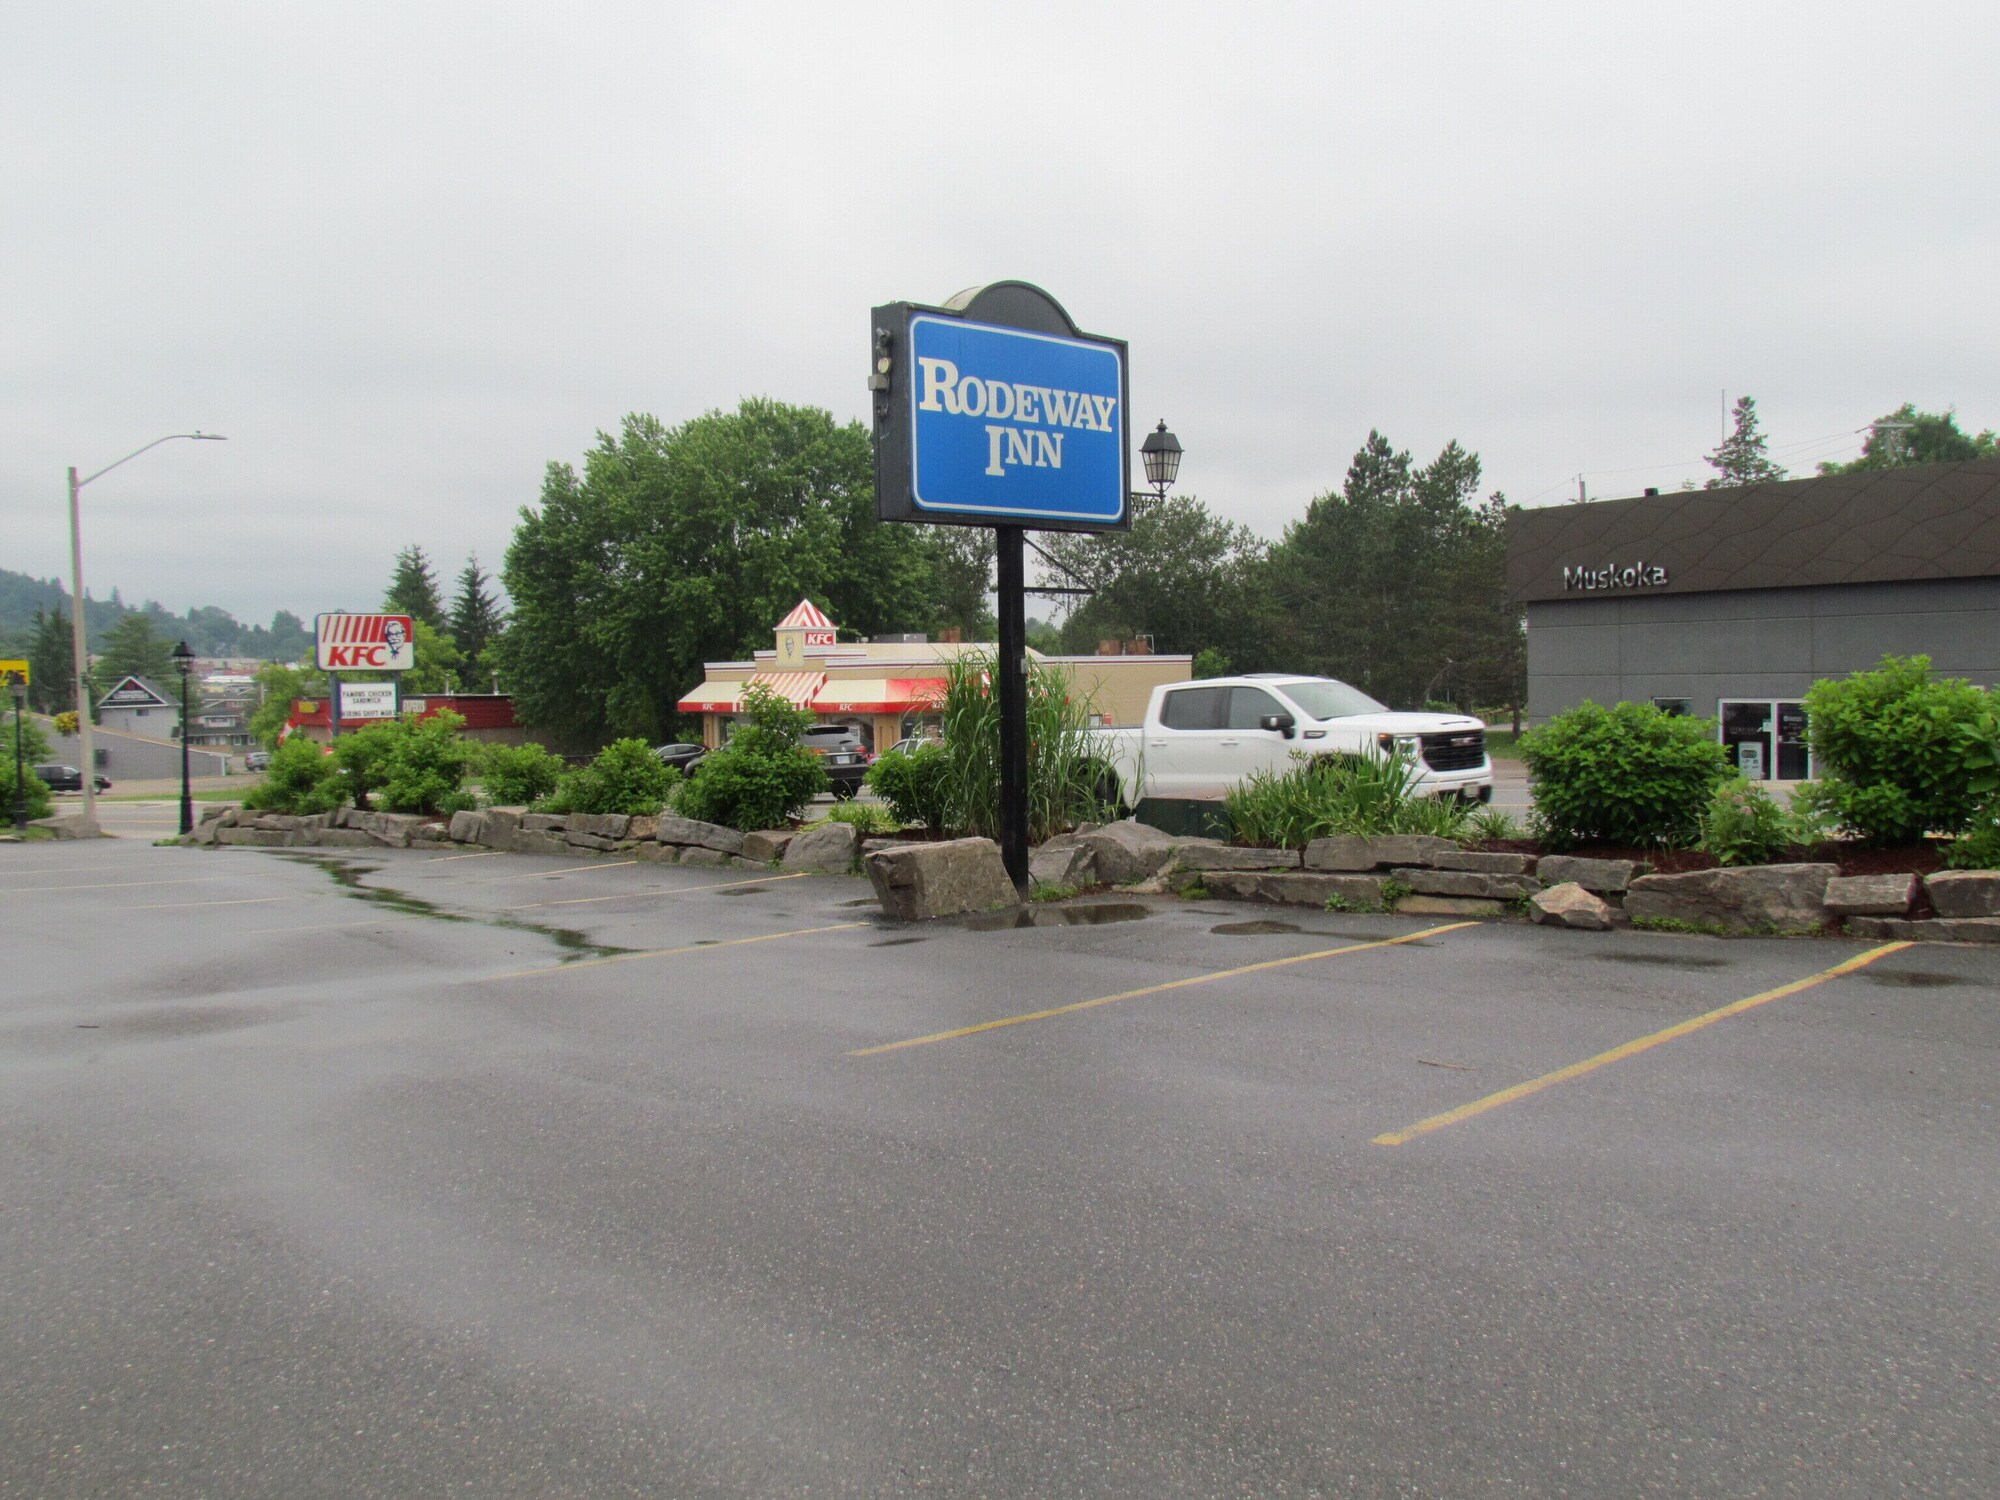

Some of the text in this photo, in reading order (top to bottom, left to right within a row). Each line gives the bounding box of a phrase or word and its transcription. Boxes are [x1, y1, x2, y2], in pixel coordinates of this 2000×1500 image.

[918, 356, 1117, 432] RODEWAY
[985, 425, 1064, 477] INN
[1563, 561, 1668, 590] Muskoka
[806, 632, 834, 645] KFC
[328, 646, 386, 666] KFC
[838, 703, 853, 711] KFC
